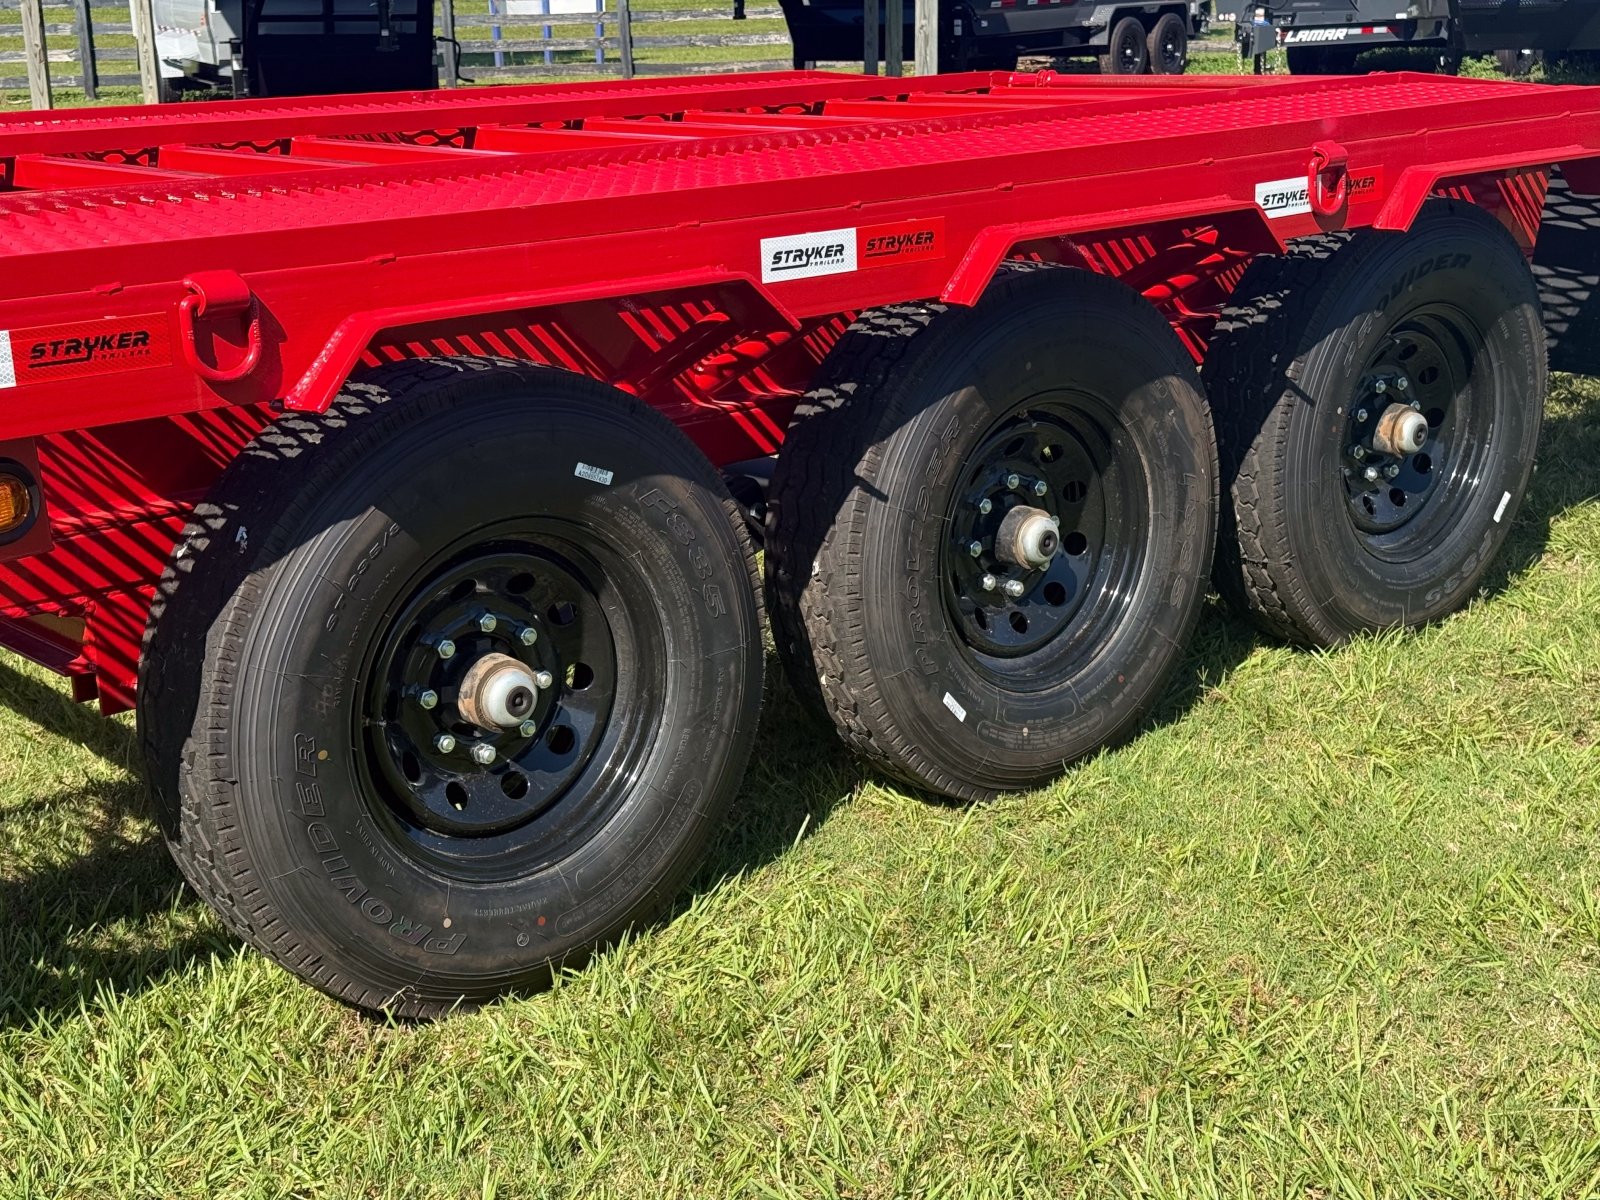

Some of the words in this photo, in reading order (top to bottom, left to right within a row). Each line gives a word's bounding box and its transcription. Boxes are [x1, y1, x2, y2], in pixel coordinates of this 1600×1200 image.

[1284, 28, 1348, 42] LAMAR
[770, 243, 845, 272] STRYKER
[864, 231, 934, 258] STRYKER
[902, 244, 934, 255] TRAILERS
[809, 257, 845, 267] TRAILERS
[28, 330, 150, 368] STRYKER
[94, 349, 151, 361] TRAILERS
[638, 488, 727, 618] F835
[294, 732, 468, 955] PROVIDER
